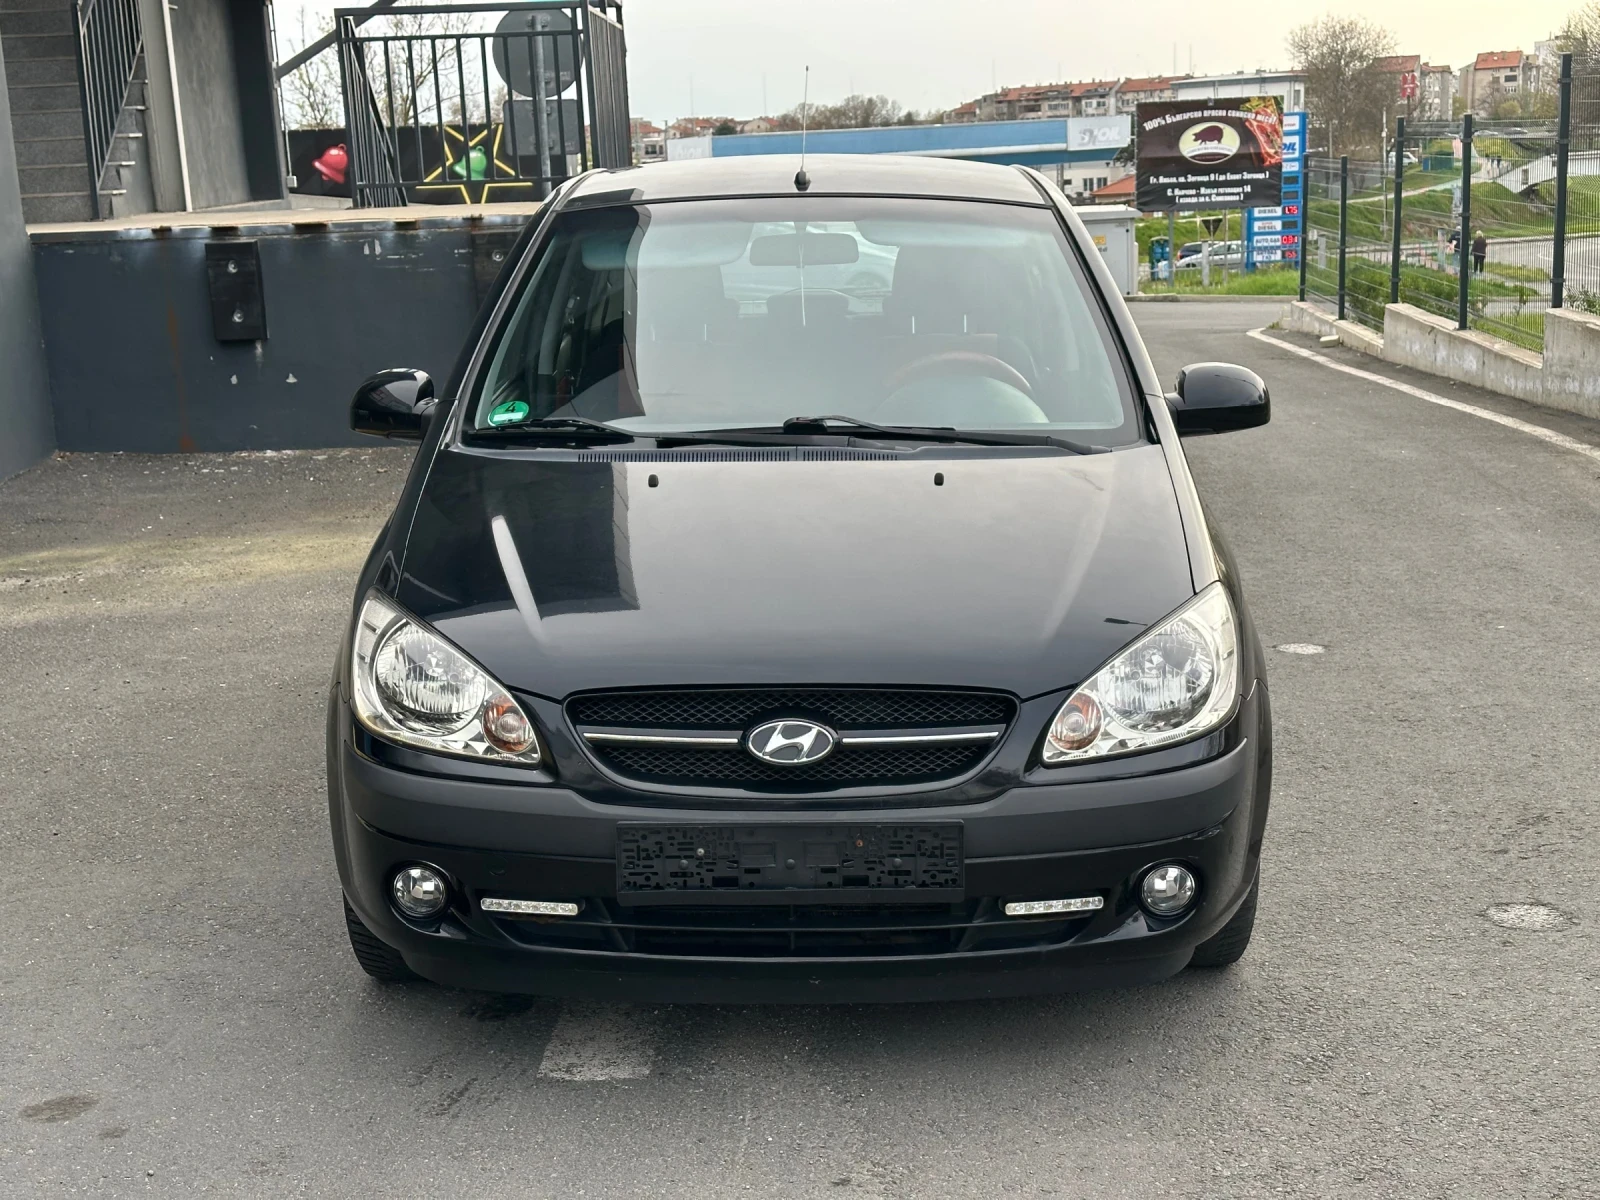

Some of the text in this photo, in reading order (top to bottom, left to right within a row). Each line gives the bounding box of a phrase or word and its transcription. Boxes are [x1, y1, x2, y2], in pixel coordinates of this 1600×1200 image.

[1143, 116, 1165, 131] 100%
[1210, 173, 1215, 181] 9
[1243, 184, 1251, 193] 14
[505, 401, 516, 412] 4
